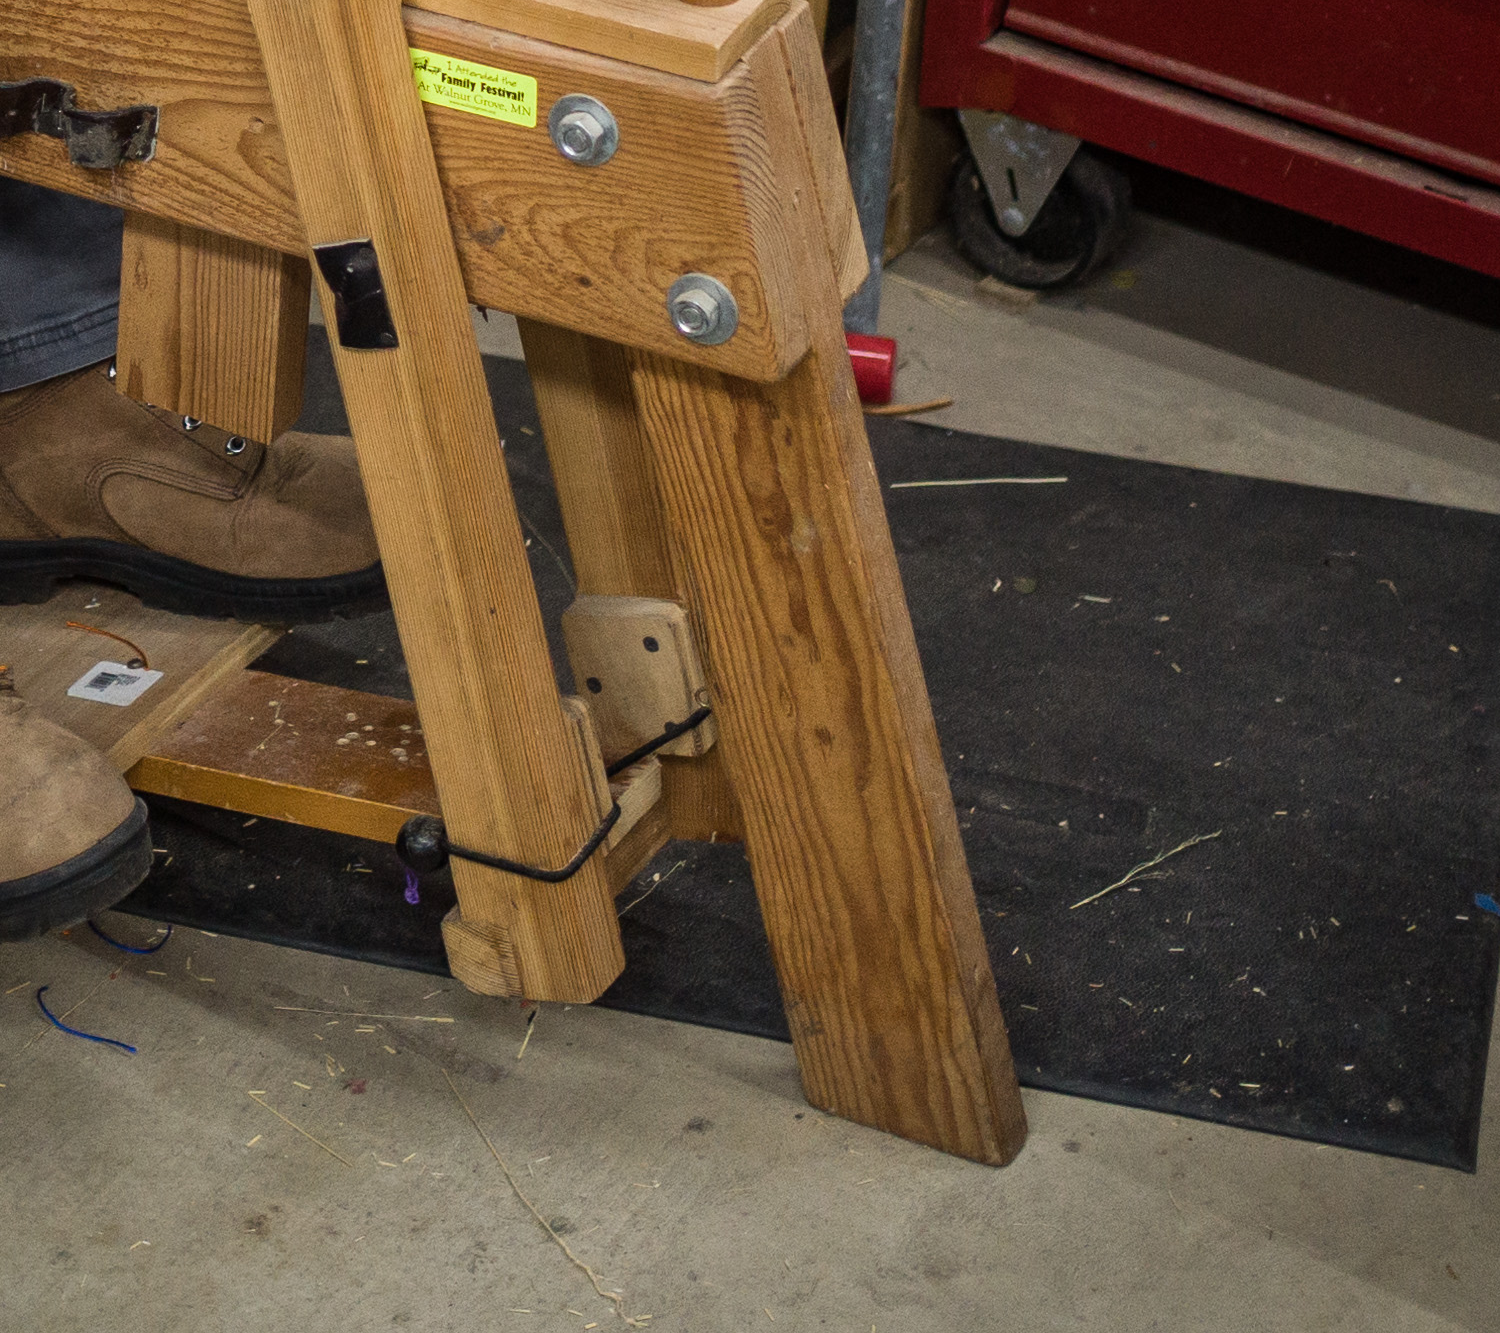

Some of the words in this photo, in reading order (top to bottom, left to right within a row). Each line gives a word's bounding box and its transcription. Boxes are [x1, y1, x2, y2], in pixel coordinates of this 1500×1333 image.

[418, 81, 429, 92] At
[433, 83, 471, 102] Walnut
[473, 94, 508, 112] Grove,
[511, 103, 532, 117] MN
[441, 72, 477, 92] Family
[480, 82, 525, 102] Festival!
